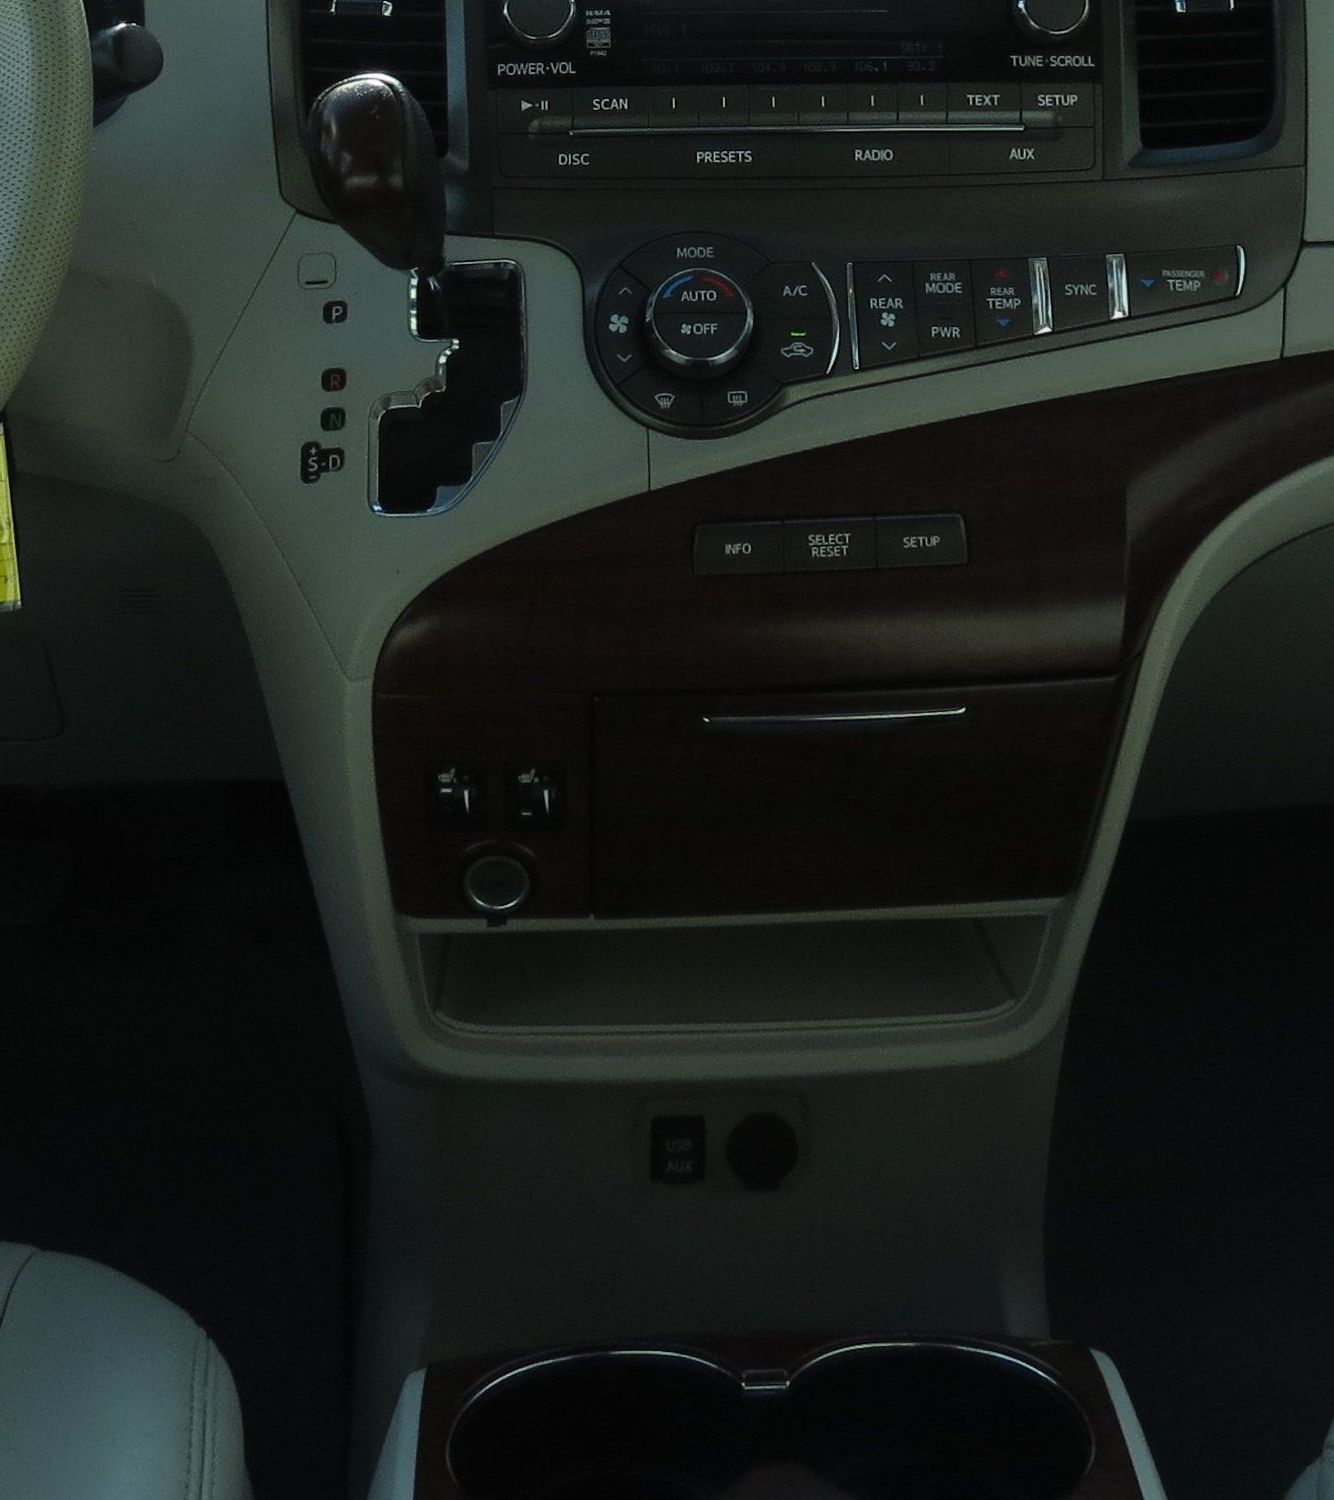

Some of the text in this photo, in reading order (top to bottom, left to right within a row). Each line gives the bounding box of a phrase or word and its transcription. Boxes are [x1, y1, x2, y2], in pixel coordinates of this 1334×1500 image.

[592, 98, 628, 112] SCAN
[966, 94, 1002, 107] TEXT
[1037, 94, 1079, 107] SETUP
[558, 153, 590, 166] DISC
[696, 150, 753, 164] PRESETS
[854, 148, 895, 162] RADIO
[1009, 148, 1036, 161] AUX
[676, 246, 715, 259] MODE
[929, 272, 957, 283] REAR
[782, 284, 809, 298] A/C
[924, 280, 964, 295] MODE
[989, 286, 1016, 297] REAR
[1064, 283, 1098, 297] SYNC
[1166, 279, 1202, 293] TEMP
[680, 288, 718, 303] AUTO
[869, 297, 904, 310] REAR
[986, 296, 1023, 311] TEMP
[330, 306, 344, 321] P
[693, 322, 719, 336] OFF
[931, 326, 962, 339] PWR
[330, 374, 342, 389] R
[329, 413, 342, 428] N
[808, 533, 851, 547] SELECT
[902, 535, 941, 550] SETUP
[725, 542, 752, 555] INFO
[810, 545, 849, 558] RESET
[666, 1138, 692, 1153] USB
[666, 1160, 694, 1174] AUX
